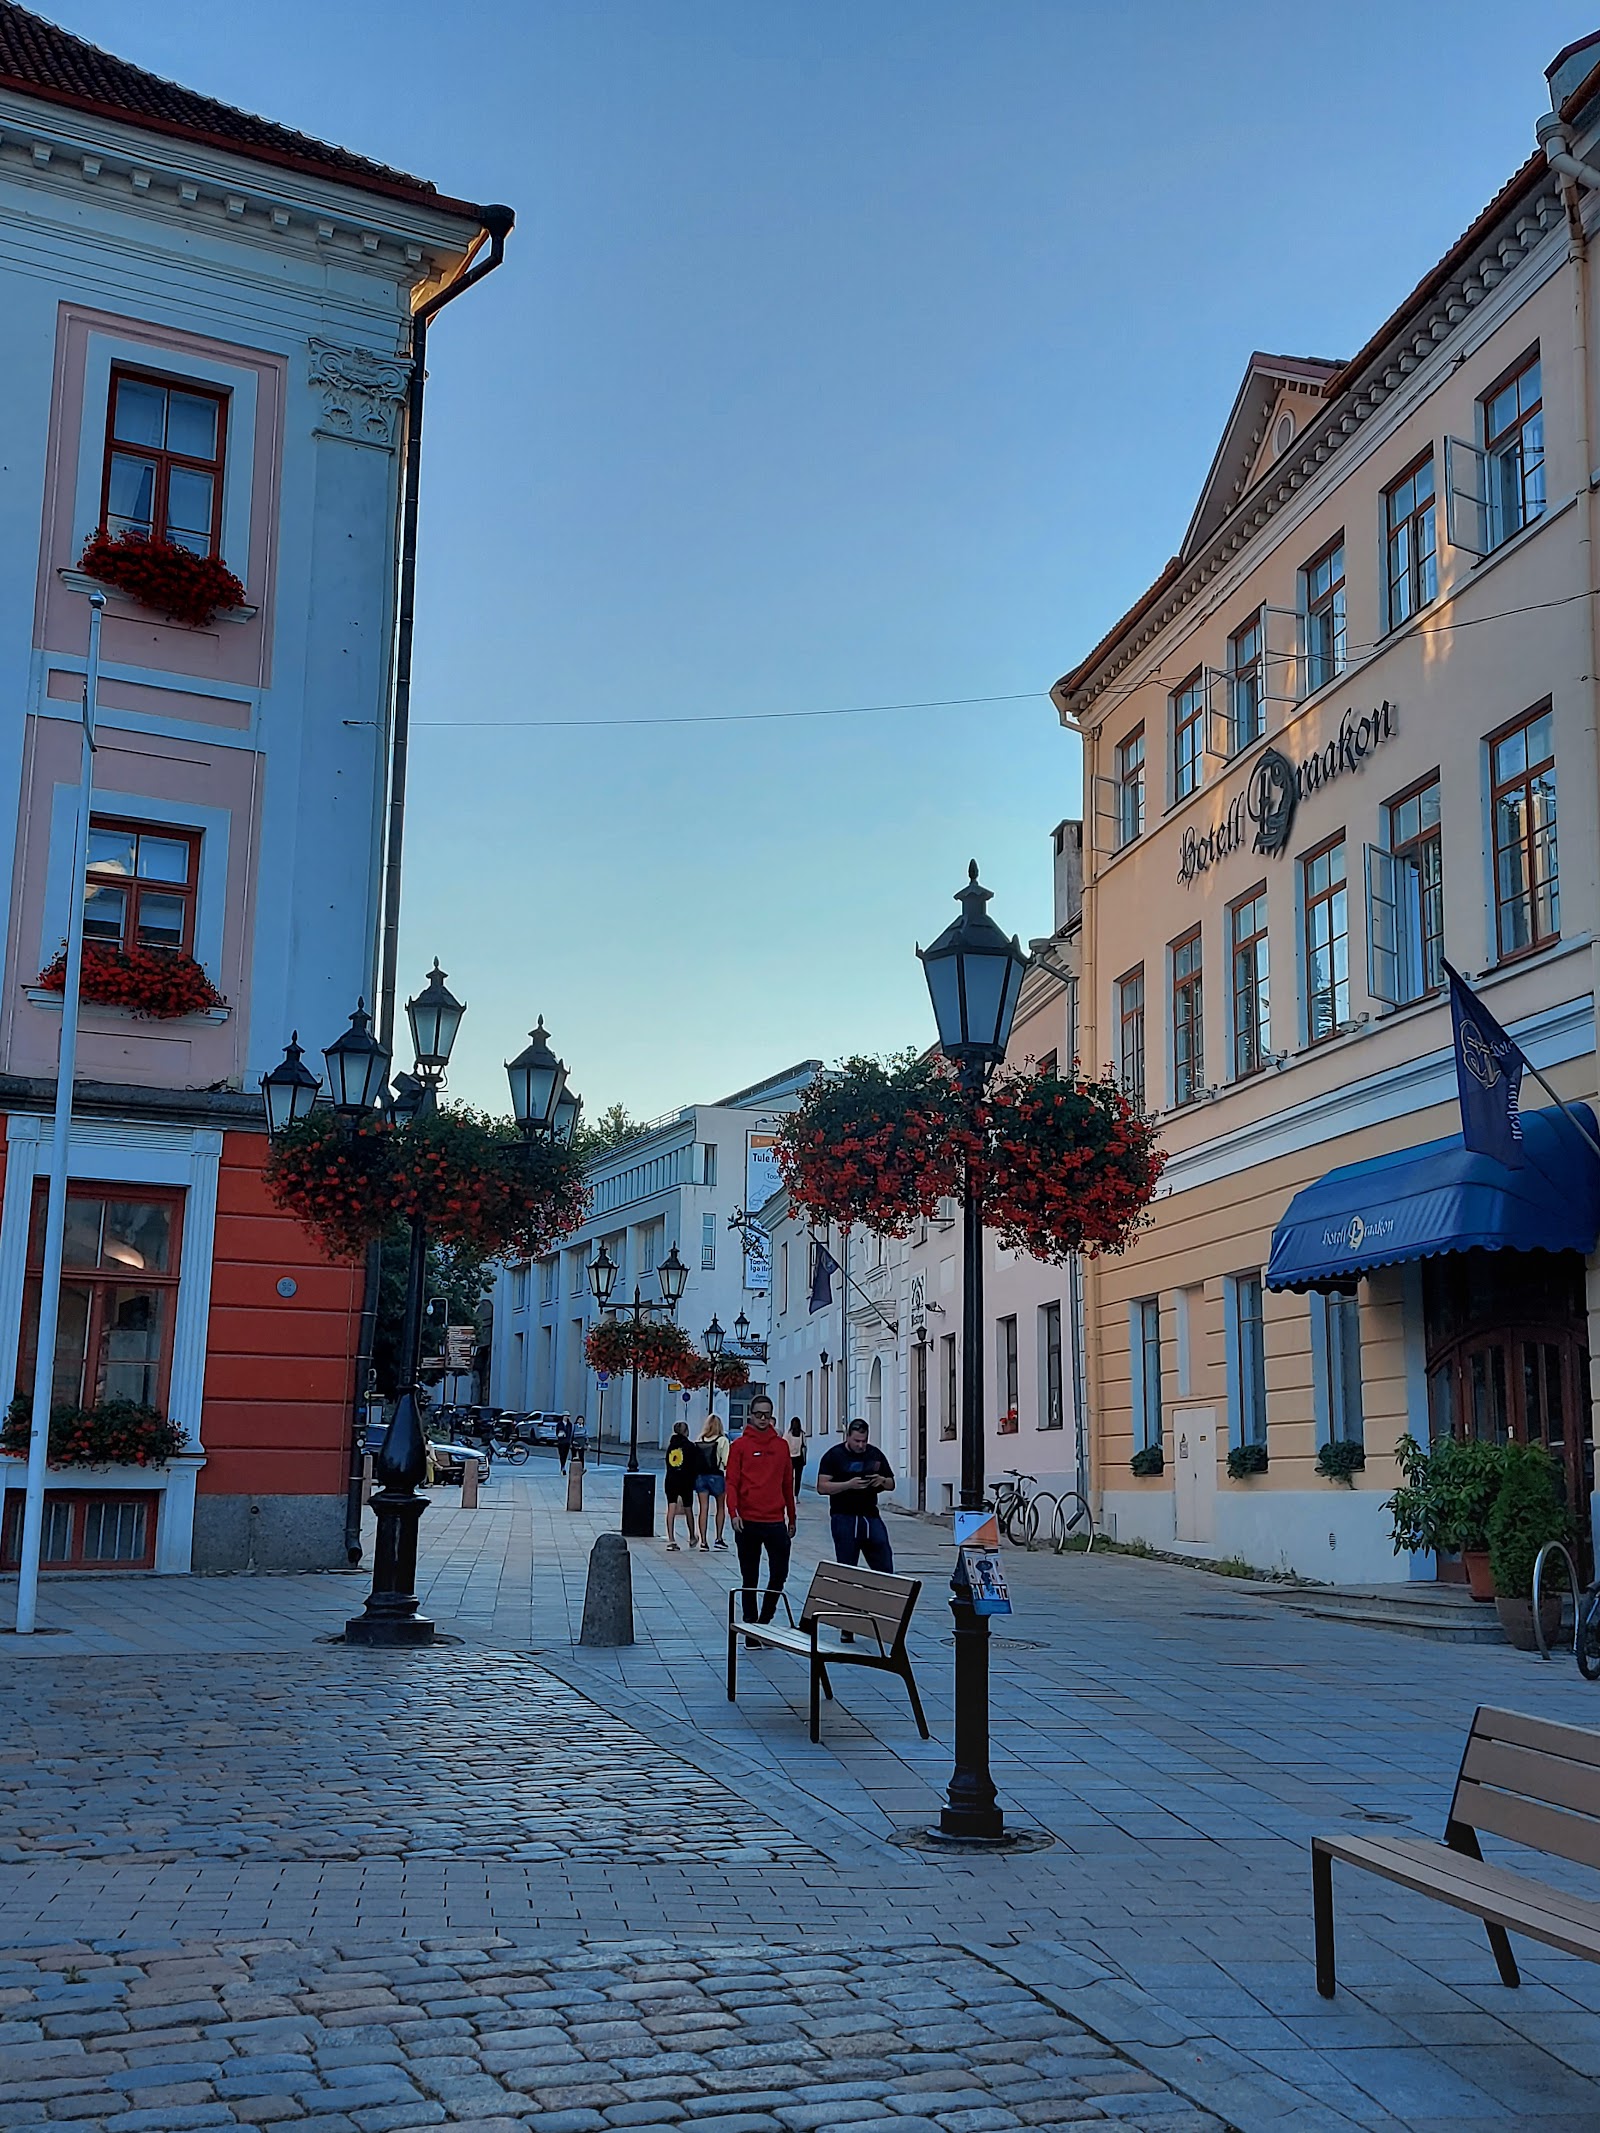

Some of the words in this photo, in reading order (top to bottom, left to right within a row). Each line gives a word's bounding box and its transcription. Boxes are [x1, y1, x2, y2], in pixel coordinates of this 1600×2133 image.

[1247, 700, 1396, 859] Draakon
[753, 1153, 769, 1163] Tule
[958, 1514, 966, 1525] 4
